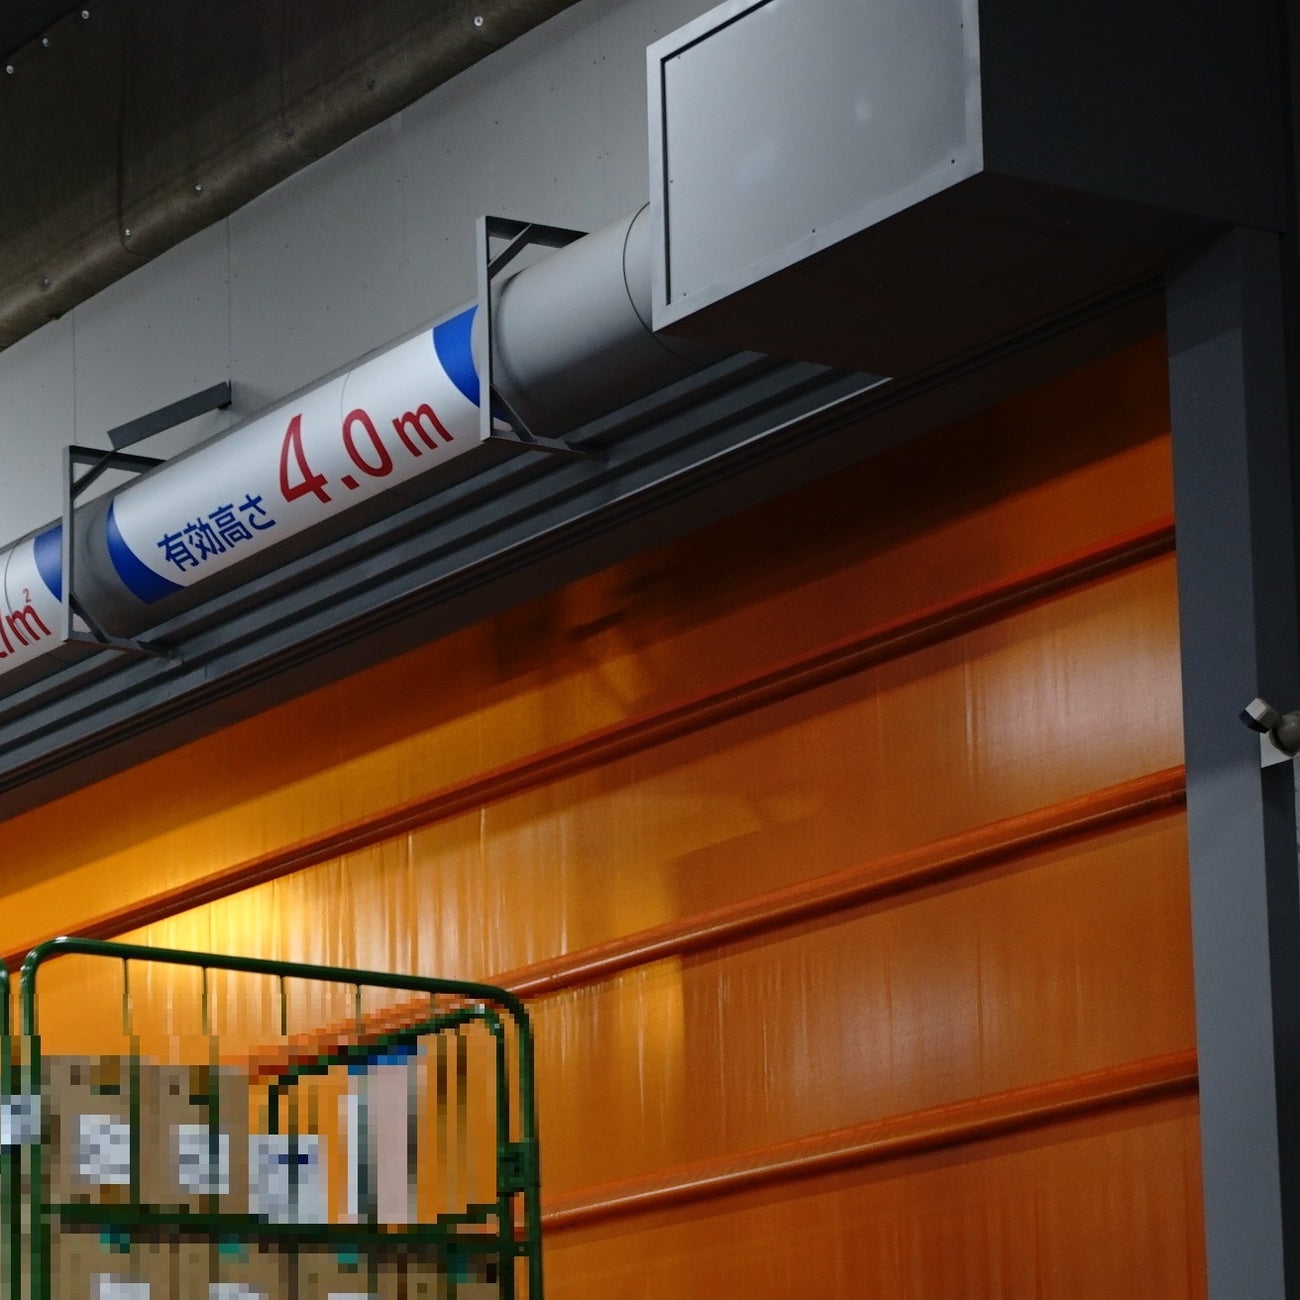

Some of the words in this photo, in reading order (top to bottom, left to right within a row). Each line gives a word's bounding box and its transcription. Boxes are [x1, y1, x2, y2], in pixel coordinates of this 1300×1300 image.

[157, 493, 276, 572] 有効高さ
[279, 403, 454, 504] 4.0m
